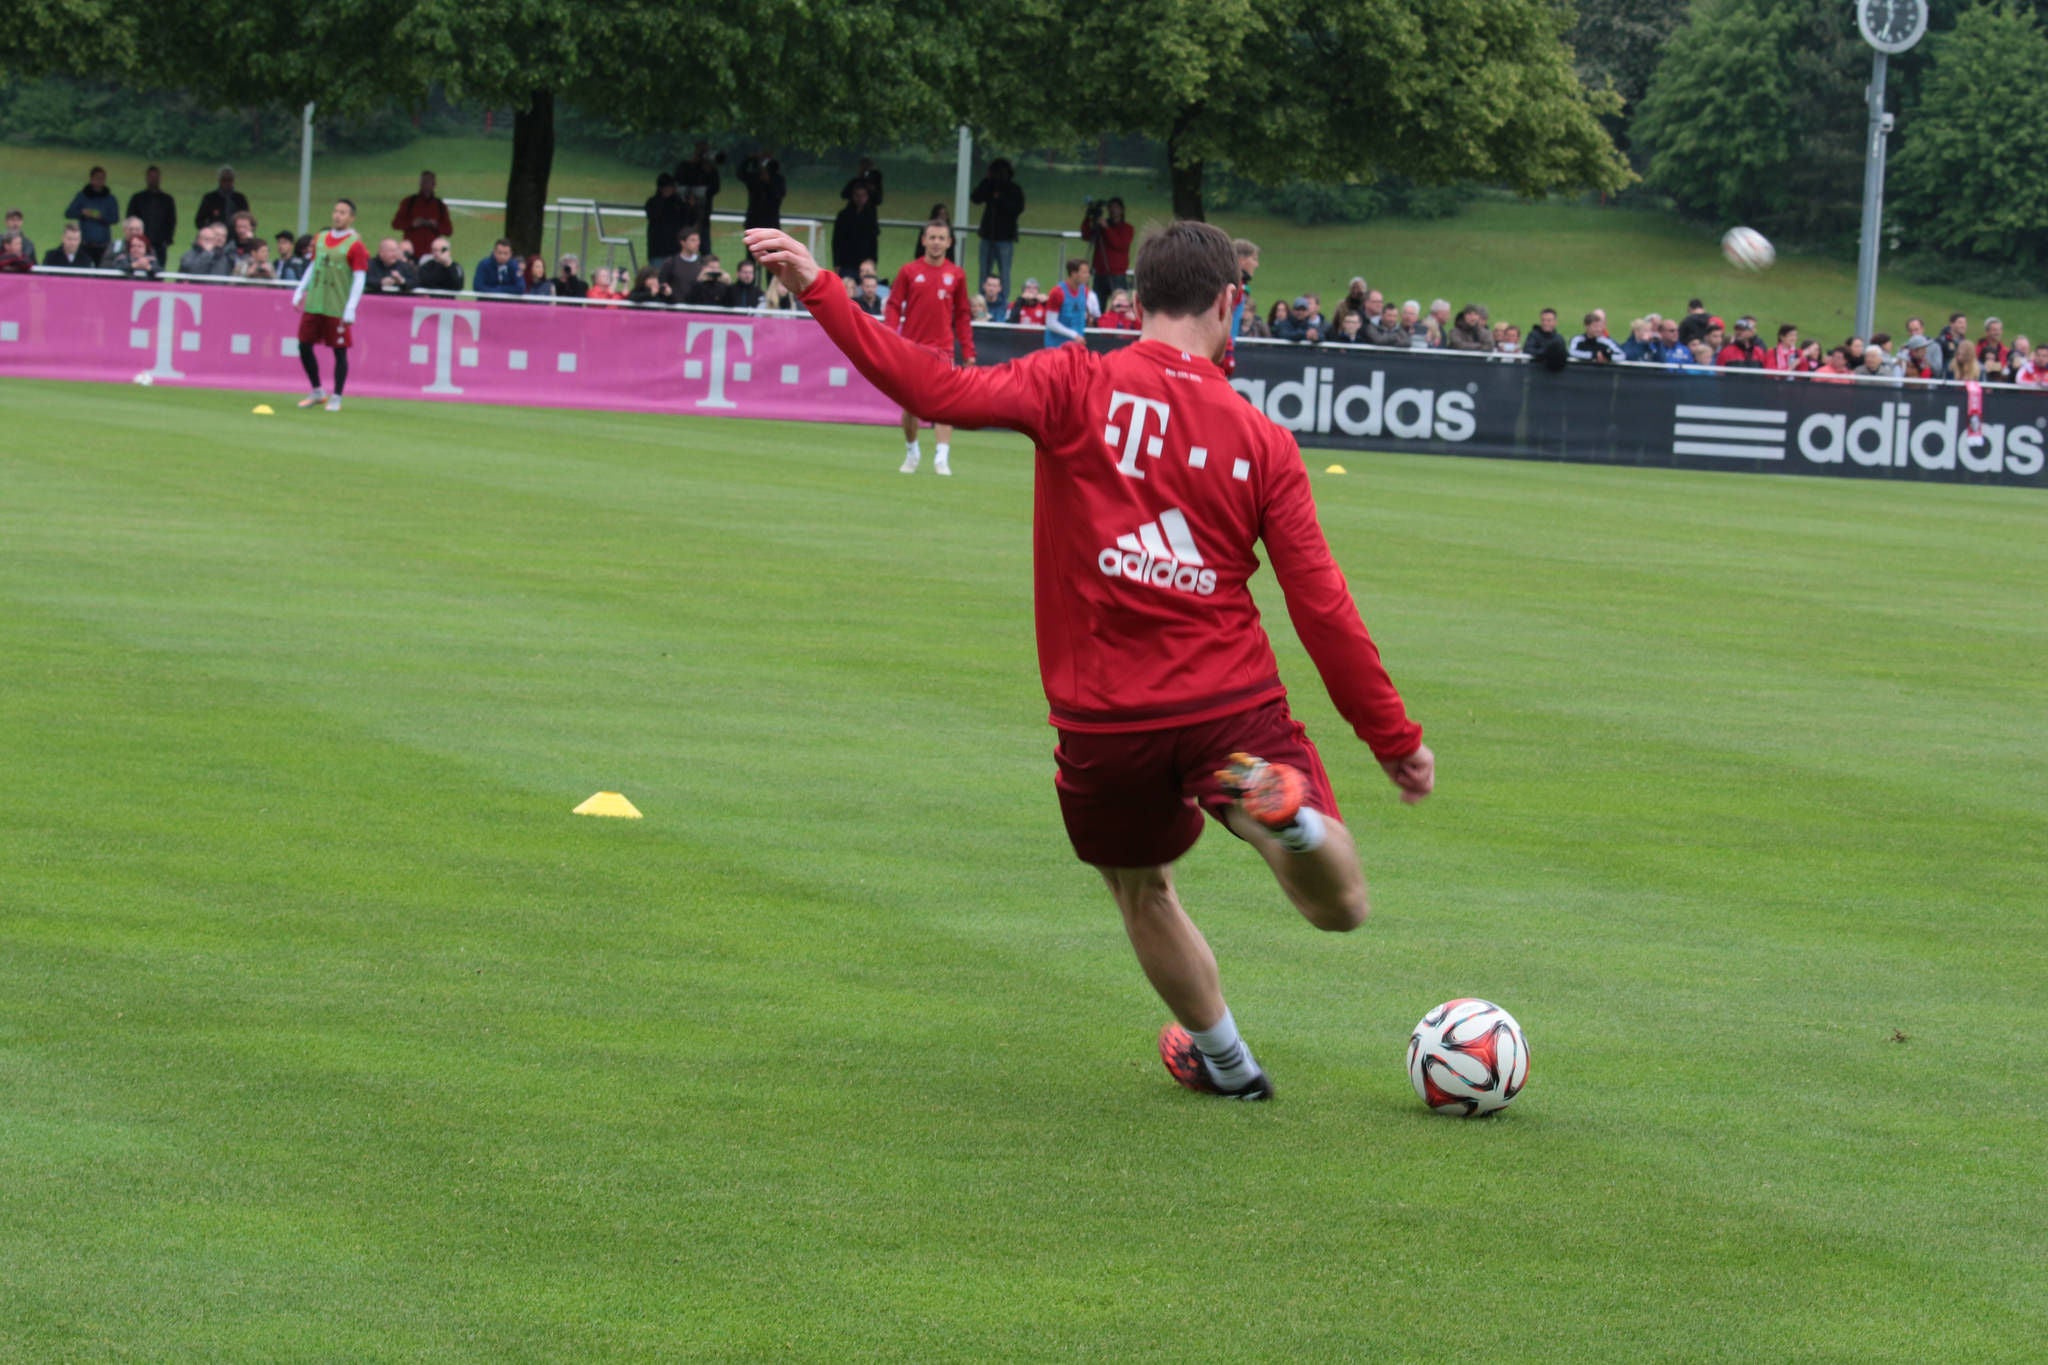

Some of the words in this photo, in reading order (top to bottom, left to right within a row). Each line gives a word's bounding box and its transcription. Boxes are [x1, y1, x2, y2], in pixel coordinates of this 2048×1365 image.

[410, 306, 481, 394] T
[683, 321, 754, 409] T
[1797, 402, 2045, 476] adidas
[1098, 547, 1217, 595] adidas
